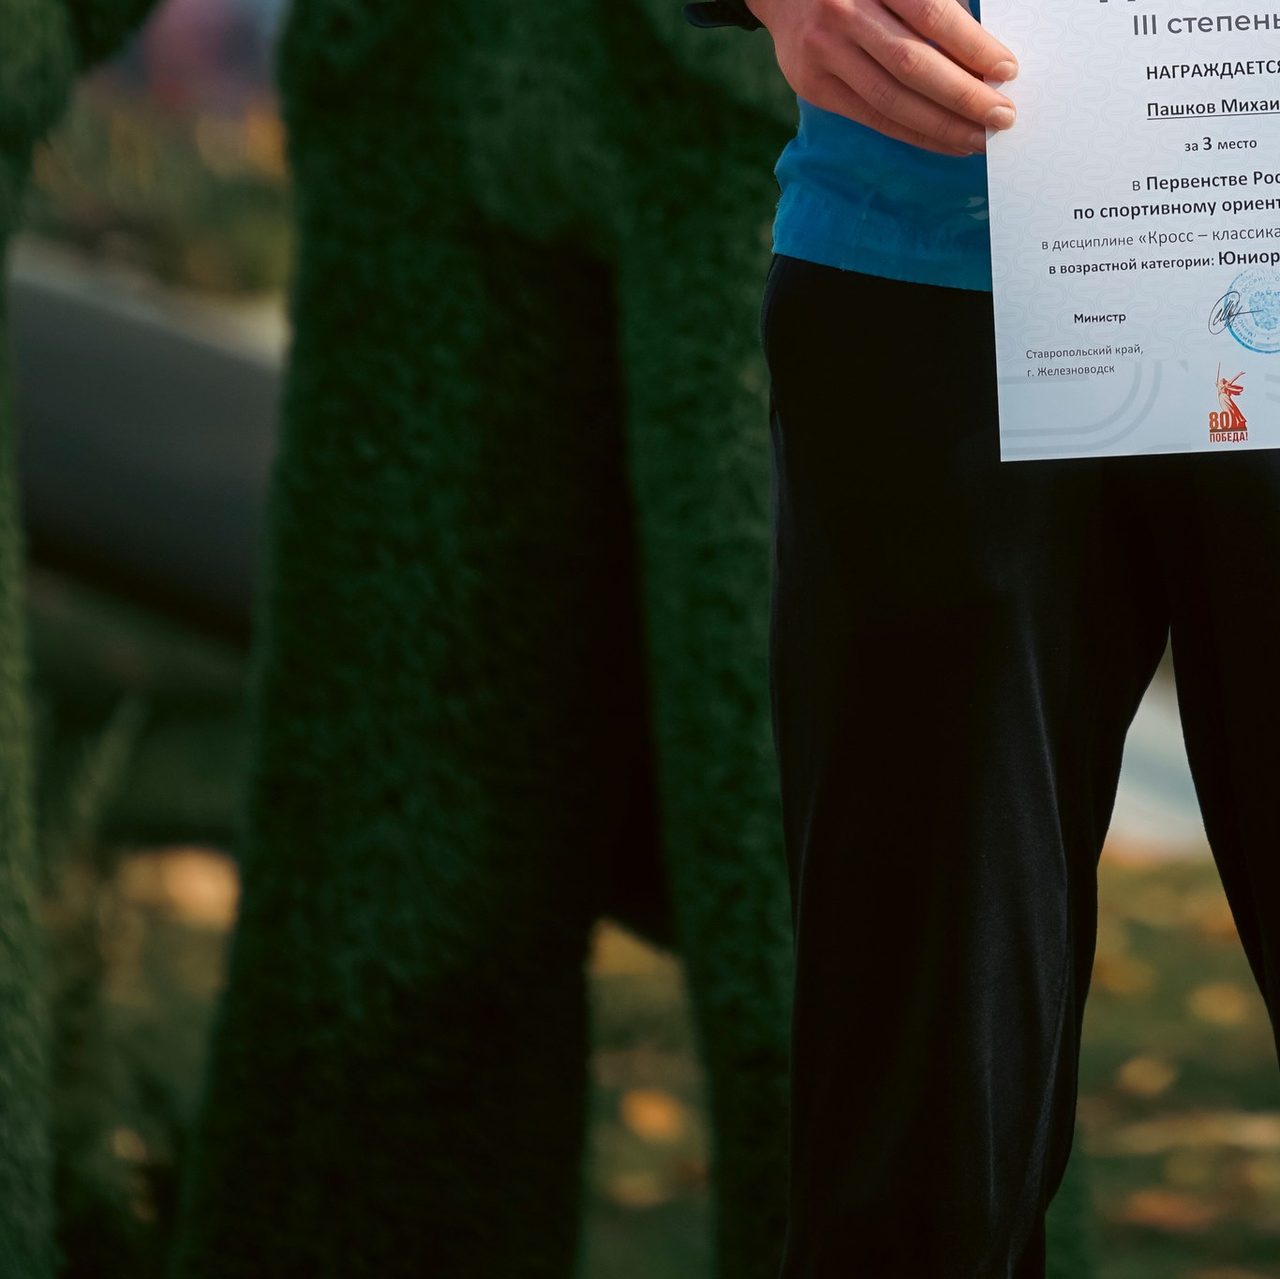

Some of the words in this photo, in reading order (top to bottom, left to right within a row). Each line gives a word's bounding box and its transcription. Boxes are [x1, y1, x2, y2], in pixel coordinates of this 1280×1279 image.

[1147, 102, 1216, 117] Пашков
[1184, 142, 1199, 152] за
[1202, 136, 1213, 151] 3
[1217, 139, 1258, 150] место
[1132, 180, 1141, 192] в
[1146, 174, 1248, 193] Первенстве
[1073, 208, 1095, 220] по
[1099, 201, 1217, 220] спортивному
[1041, 241, 1049, 250] в
[1051, 236, 1134, 252] дисциплине
[1138, 230, 1194, 248] «Кросс
[1048, 265, 1057, 275] в
[1060, 258, 1137, 276] возрастной
[1141, 257, 1215, 271] категории:
[1073, 313, 1127, 324] Министр
[1025, 345, 1112, 360] Ставропольский
[1115, 343, 1144, 357] край,
[1037, 365, 1115, 377] Железноводск
[1208, 411, 1230, 430] 80
[1209, 431, 1249, 444] ПОБЕДА!
